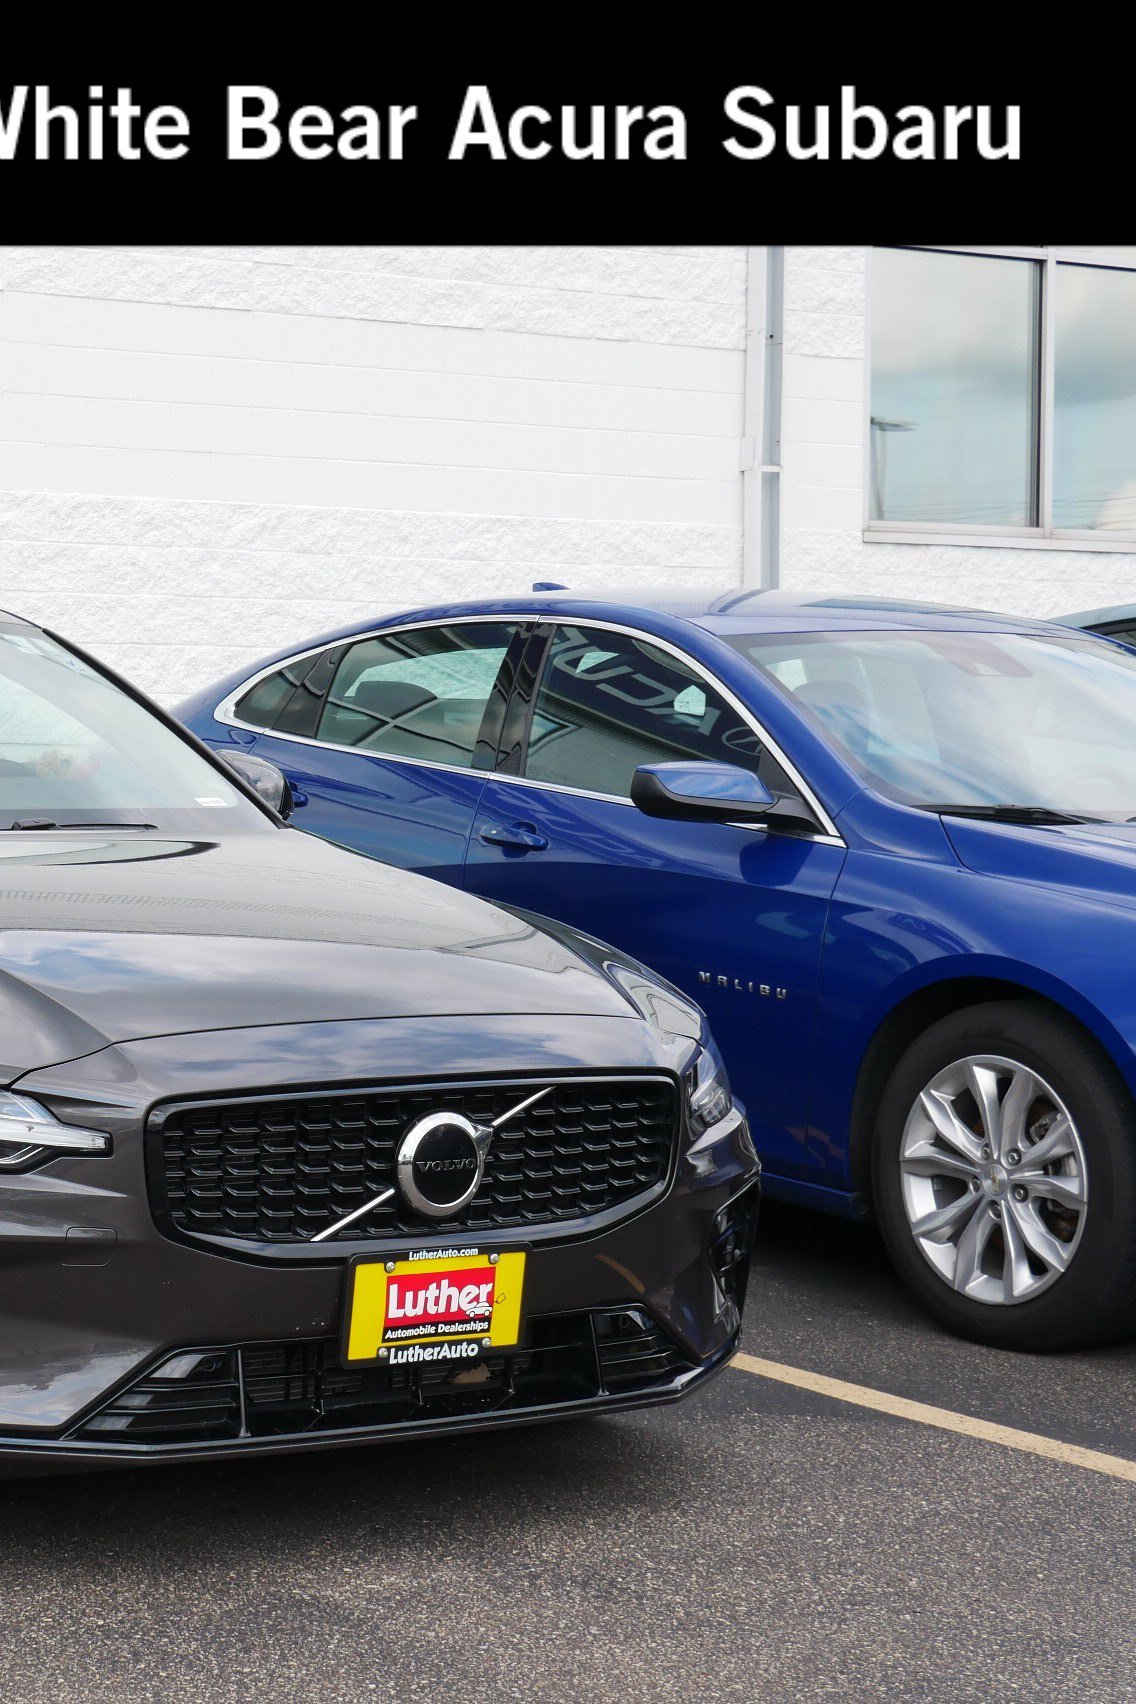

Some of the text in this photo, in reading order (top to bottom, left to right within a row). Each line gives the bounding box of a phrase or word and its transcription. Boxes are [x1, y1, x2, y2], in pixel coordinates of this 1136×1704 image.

[698, 971, 787, 999] MALIBU
[415, 1158, 476, 1173] VOLVO
[408, 1248, 479, 1261] LutherAuto.com
[387, 1278, 494, 1319] Luther
[384, 1320, 489, 1340] Automobile Dealerships
[389, 1342, 479, 1365] LutherAuto
